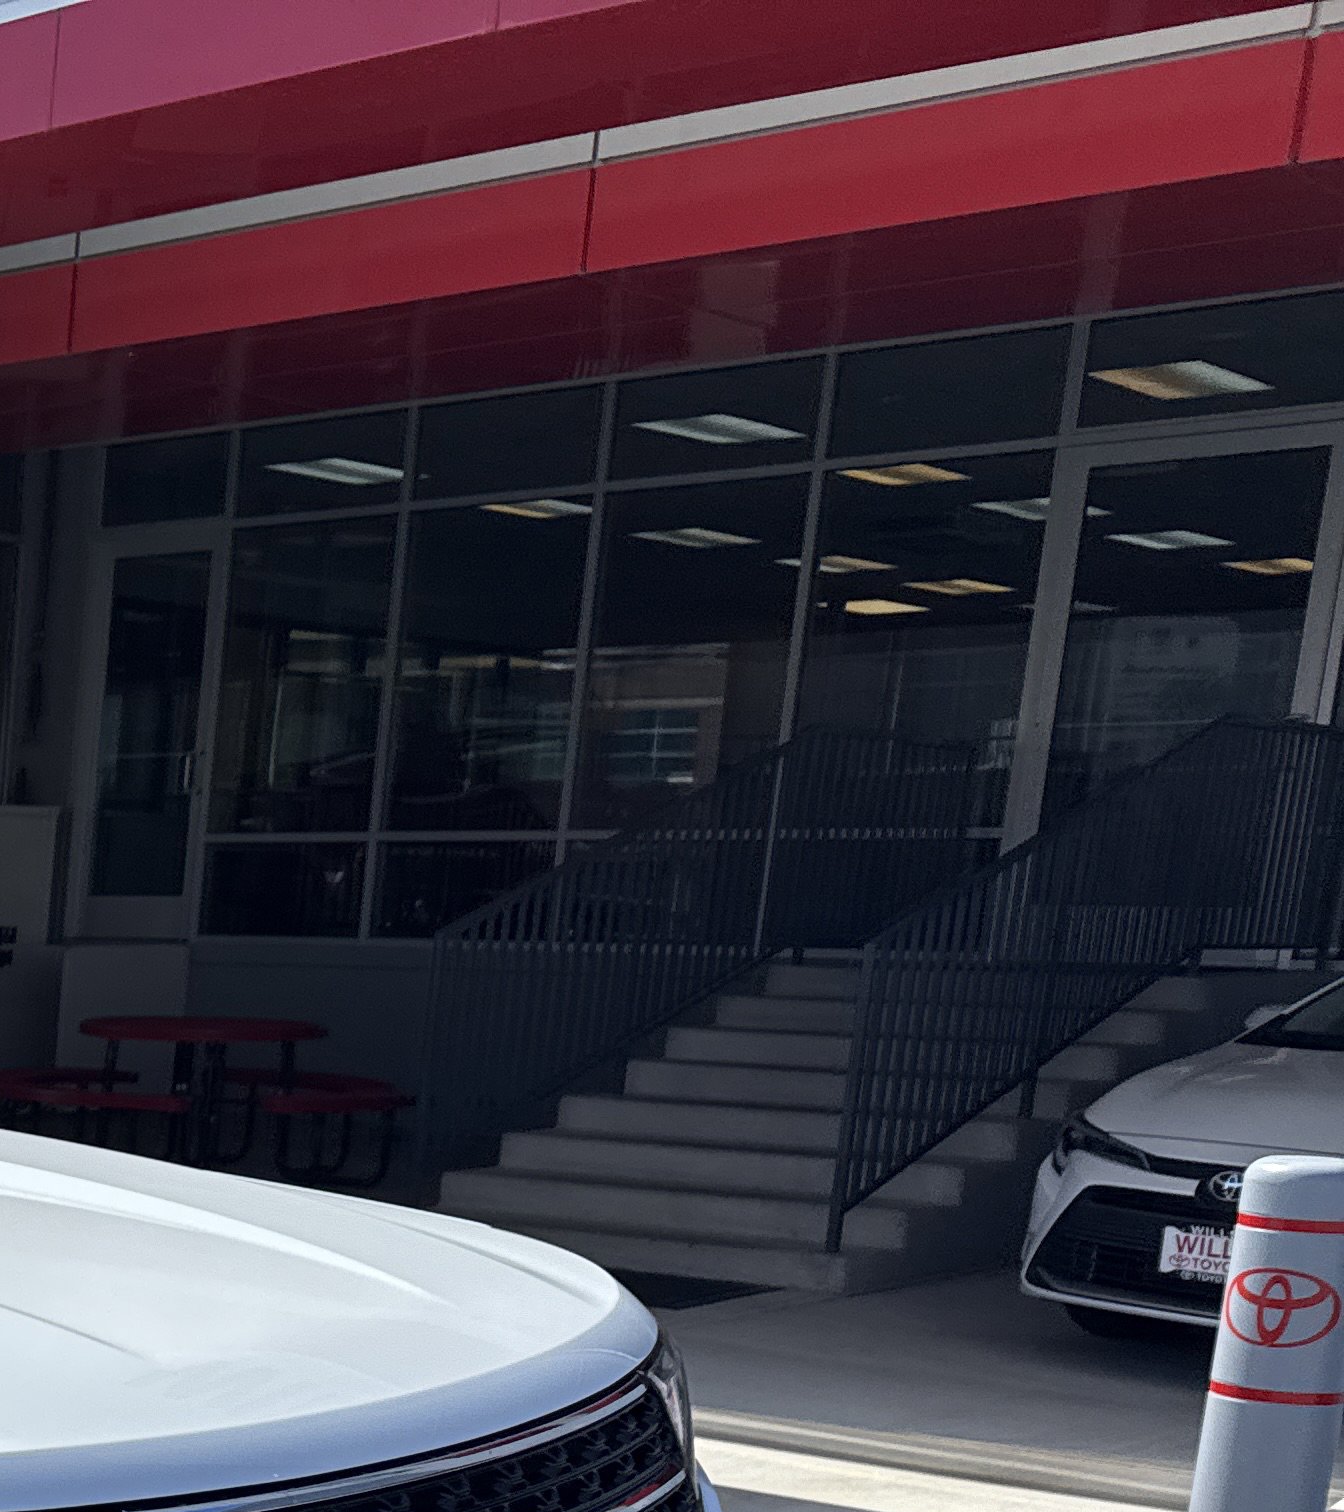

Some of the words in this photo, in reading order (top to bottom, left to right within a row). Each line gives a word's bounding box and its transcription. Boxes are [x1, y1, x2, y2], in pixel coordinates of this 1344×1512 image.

[1190, 1225, 1234, 1240] WILL
[1175, 1234, 1231, 1259] WILL
[1192, 1257, 1230, 1273] TOYO
[1197, 1271, 1225, 1284] TOYO
